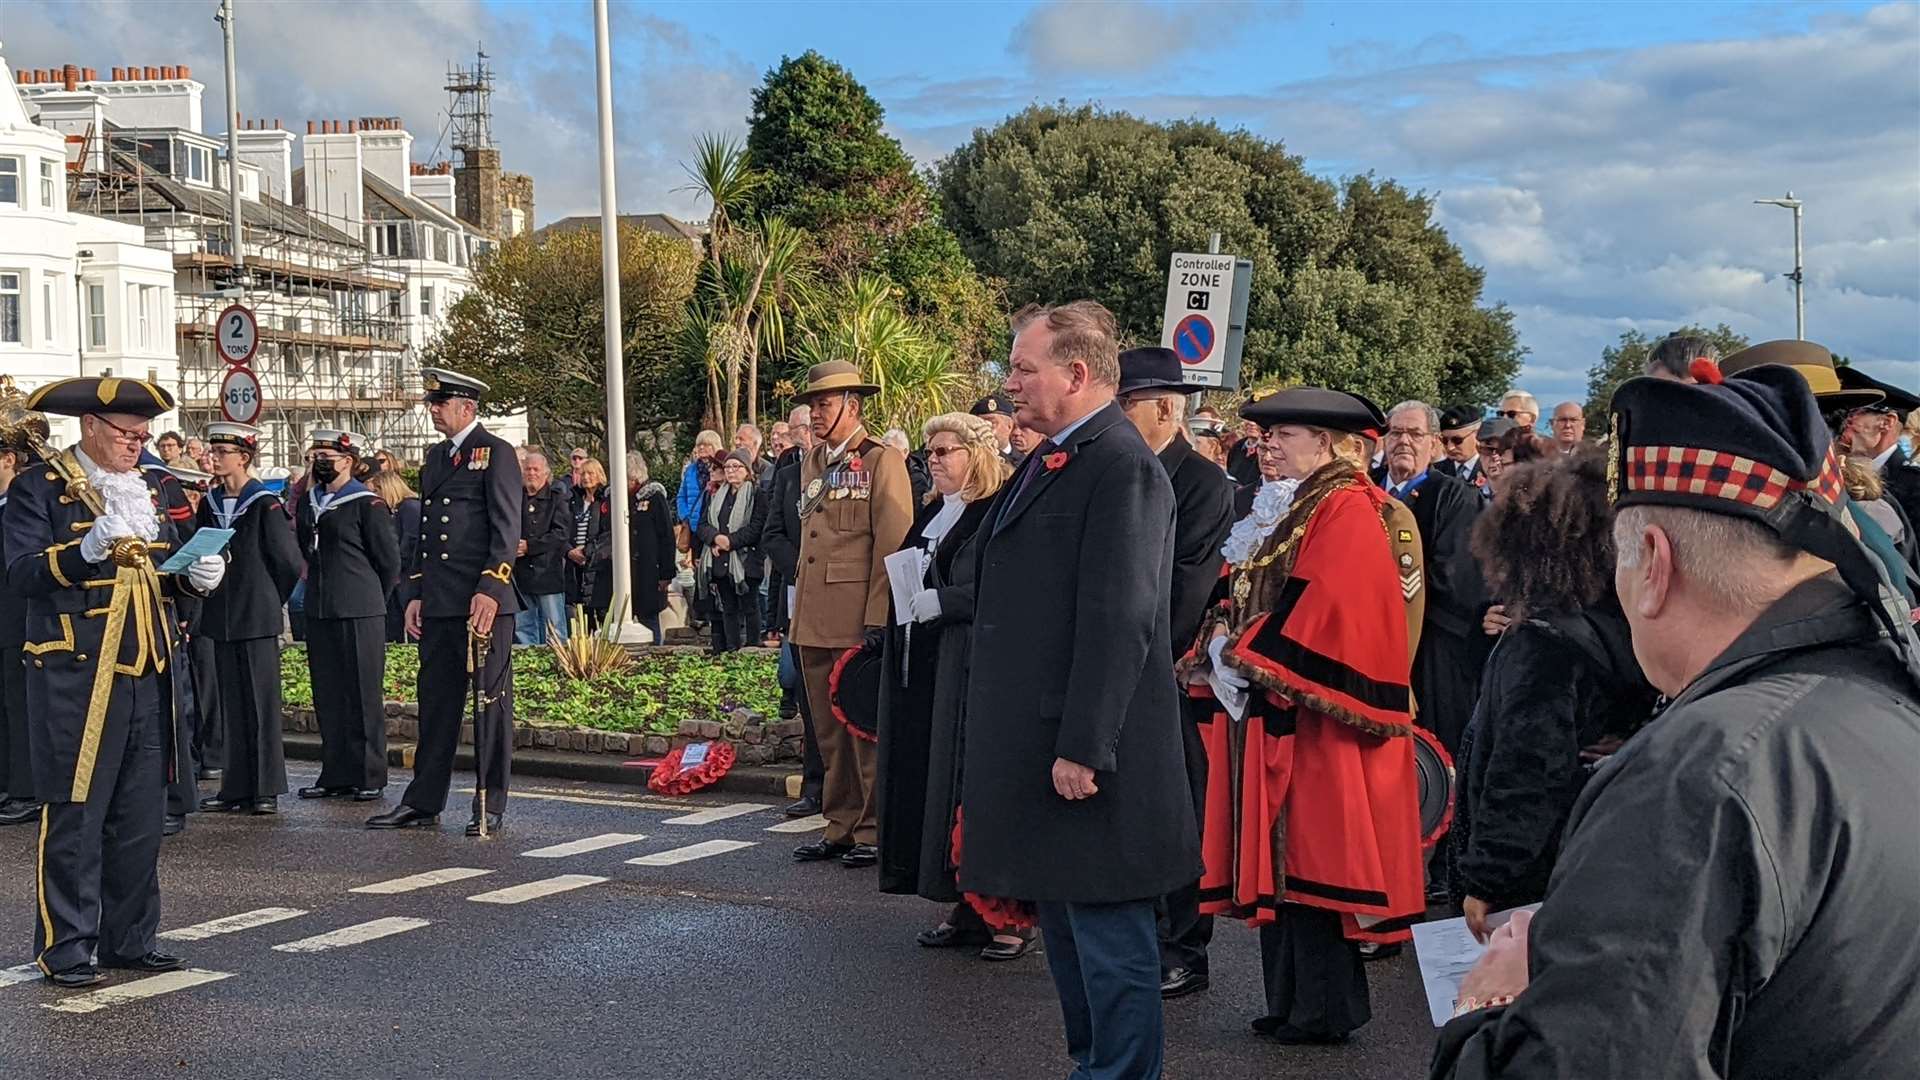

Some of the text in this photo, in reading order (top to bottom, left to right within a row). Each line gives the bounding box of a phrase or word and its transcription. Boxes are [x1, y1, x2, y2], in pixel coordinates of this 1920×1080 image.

[1175, 258, 1231, 271] Controlled
[1181, 273, 1220, 287] ZONE
[1189, 293, 1207, 308] C1
[230, 314, 243, 338] 2
[227, 345, 249, 354] TONS
